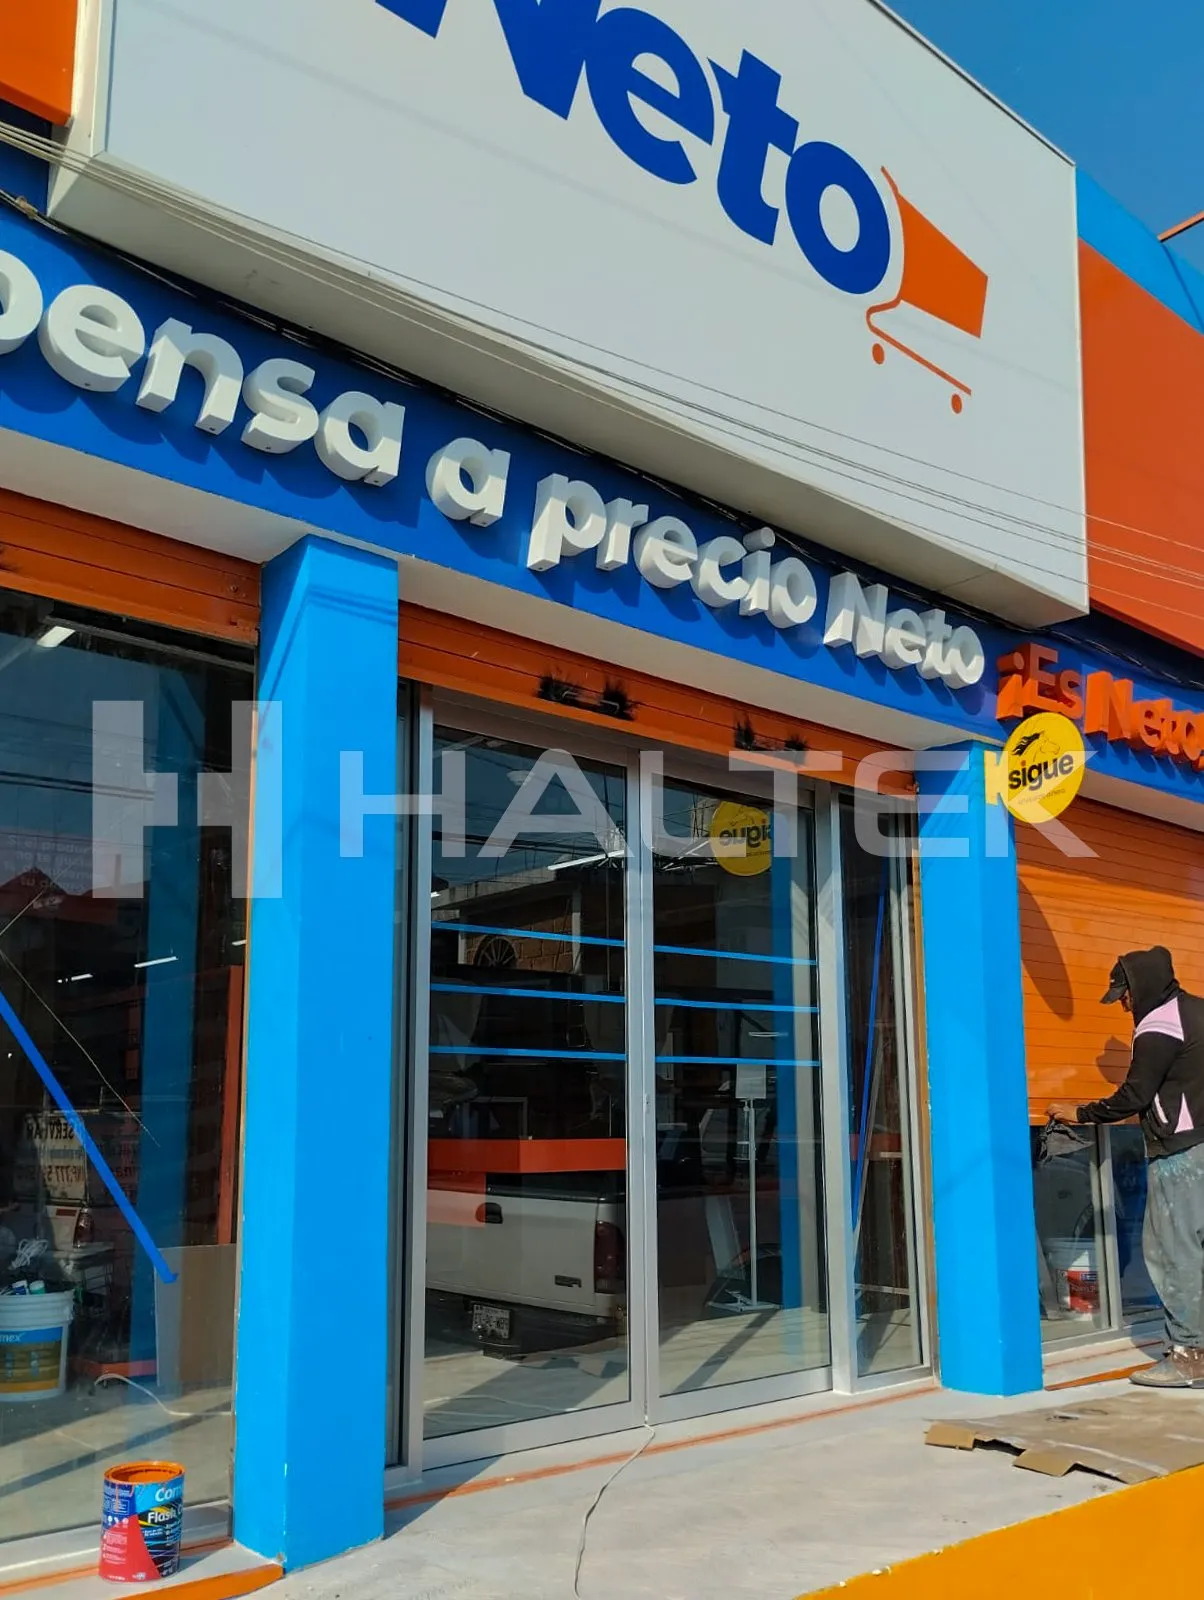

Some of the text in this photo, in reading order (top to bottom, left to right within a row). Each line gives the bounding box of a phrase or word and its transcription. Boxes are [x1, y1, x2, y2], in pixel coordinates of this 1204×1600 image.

[426, 437, 511, 527] a
[527, 513, 818, 629] precio
[823, 572, 985, 689] Neto
[1008, 754, 1074, 791] sigue
